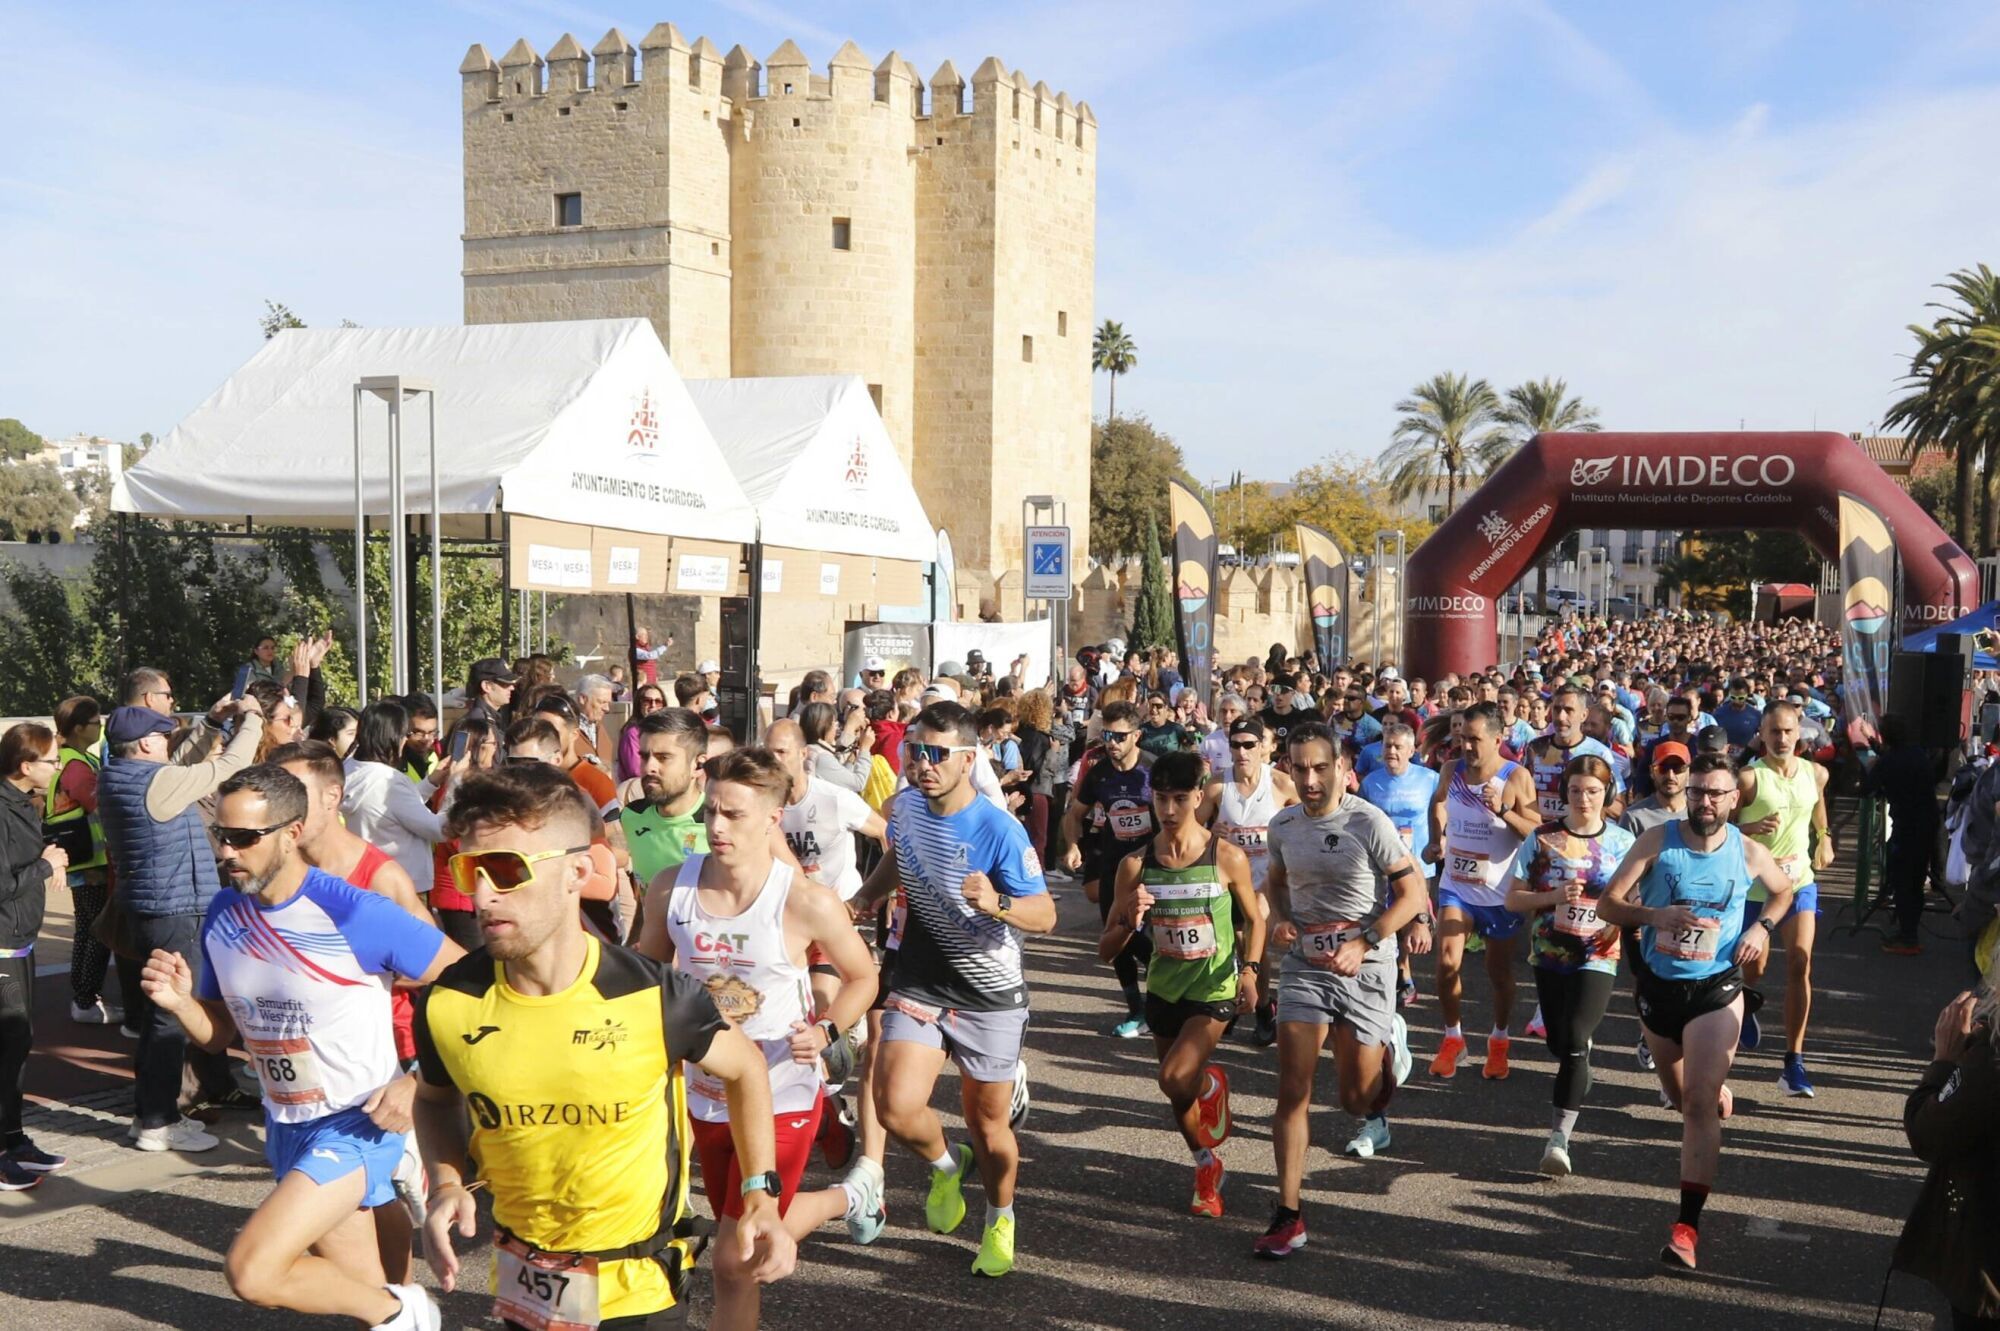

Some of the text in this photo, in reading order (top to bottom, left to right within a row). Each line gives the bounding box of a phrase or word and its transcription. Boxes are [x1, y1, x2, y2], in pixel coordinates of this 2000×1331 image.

[1622, 454, 1795, 487] IMDECO
[571, 472, 646, 499] AYUNTAMIENTO
[648, 484, 660, 502] DE
[1571, 492, 1792, 505] Instituto Municipal de Deportes Córdoba
[806, 508, 858, 527] AYUNTAMIENTO
[1031, 530, 1066, 538] ATENCIÓN
[1467, 503, 1552, 583] AYUNTAMIENTO DE CÓRDOBA
[532, 559, 553, 571] MESA
[563, 562, 584, 574] MESA
[612, 560, 632, 571] MESA
[680, 567, 697, 577] MESA
[1418, 596, 1485, 611] IMDECO
[1904, 604, 1970, 621] MDECO
[863, 638, 914, 647] EL CEREBRO
[864, 646, 912, 656] NO ES GRIS
[1543, 800, 1566, 812] 412
[1118, 815, 1142, 828] 625
[1237, 833, 1262, 846] 514
[1454, 857, 1477, 873] 572
[901, 834, 978, 937] HORNACHUELOS
[1567, 906, 1596, 923] 579
[694, 931, 750, 954] CAT
[1166, 928, 1199, 945] 118
[255, 996, 304, 1011] Smurfit
[260, 1008, 314, 1025] Westrock
[257, 1057, 297, 1082] 768
[467, 1091, 629, 1129] AIRZONE
[517, 1265, 570, 1307] 457
